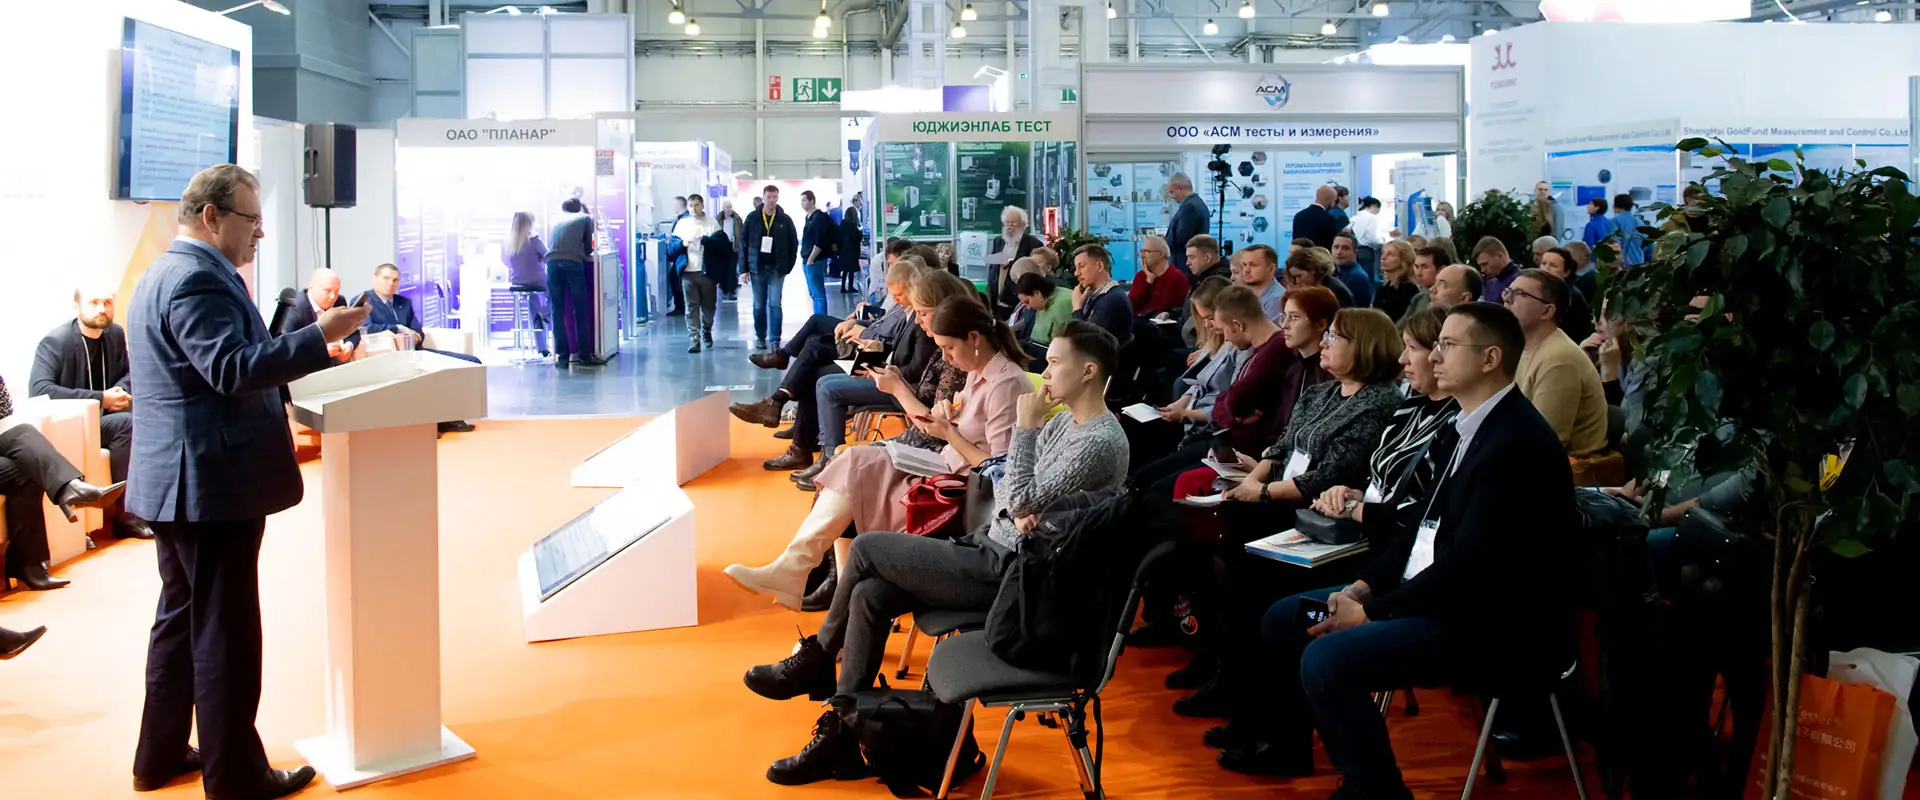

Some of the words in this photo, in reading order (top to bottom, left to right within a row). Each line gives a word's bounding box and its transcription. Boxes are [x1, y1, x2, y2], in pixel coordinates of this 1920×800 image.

[912, 120, 1011, 135] ЮДЖИЭНЛАБ
[1015, 120, 1052, 132] ТЕСТ
[1166, 125, 1199, 138] ООО
[1203, 125, 1241, 138] «АСМ
[1244, 127, 1285, 138] тесты
[1288, 128, 1297, 137] и
[1300, 126, 1380, 139] измерения»
[1683, 126, 1724, 137] ShangHai
[1726, 126, 1768, 136] GoldFund
[1770, 127, 1827, 137] Measurement
[1829, 127, 1844, 137] and
[1846, 127, 1877, 137] Control
[446, 128, 478, 141] ОАО
[482, 128, 556, 141] "ПЛАНАР"
